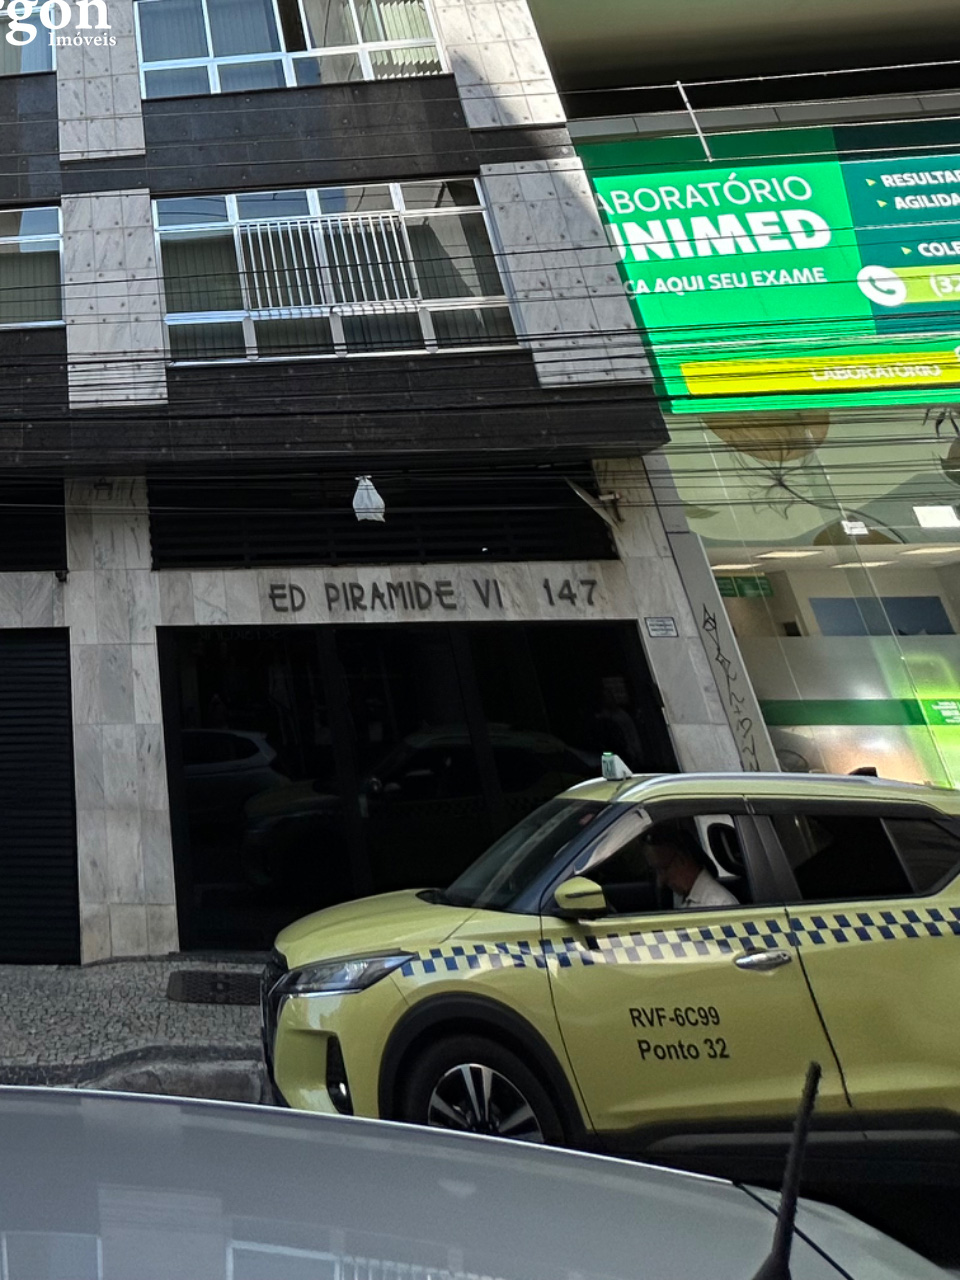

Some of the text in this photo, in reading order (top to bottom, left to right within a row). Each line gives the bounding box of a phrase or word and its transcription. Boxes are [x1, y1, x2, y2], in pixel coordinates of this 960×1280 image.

[654, 275, 705, 296] AQUI
[708, 272, 749, 290] SEU
[751, 267, 827, 287] EXAME
[269, 578, 597, 613] ED PIRAMIDE VI 147
[629, 1006, 720, 1027] RVF-6C99
[637, 1038, 730, 1060] Ponto 32
